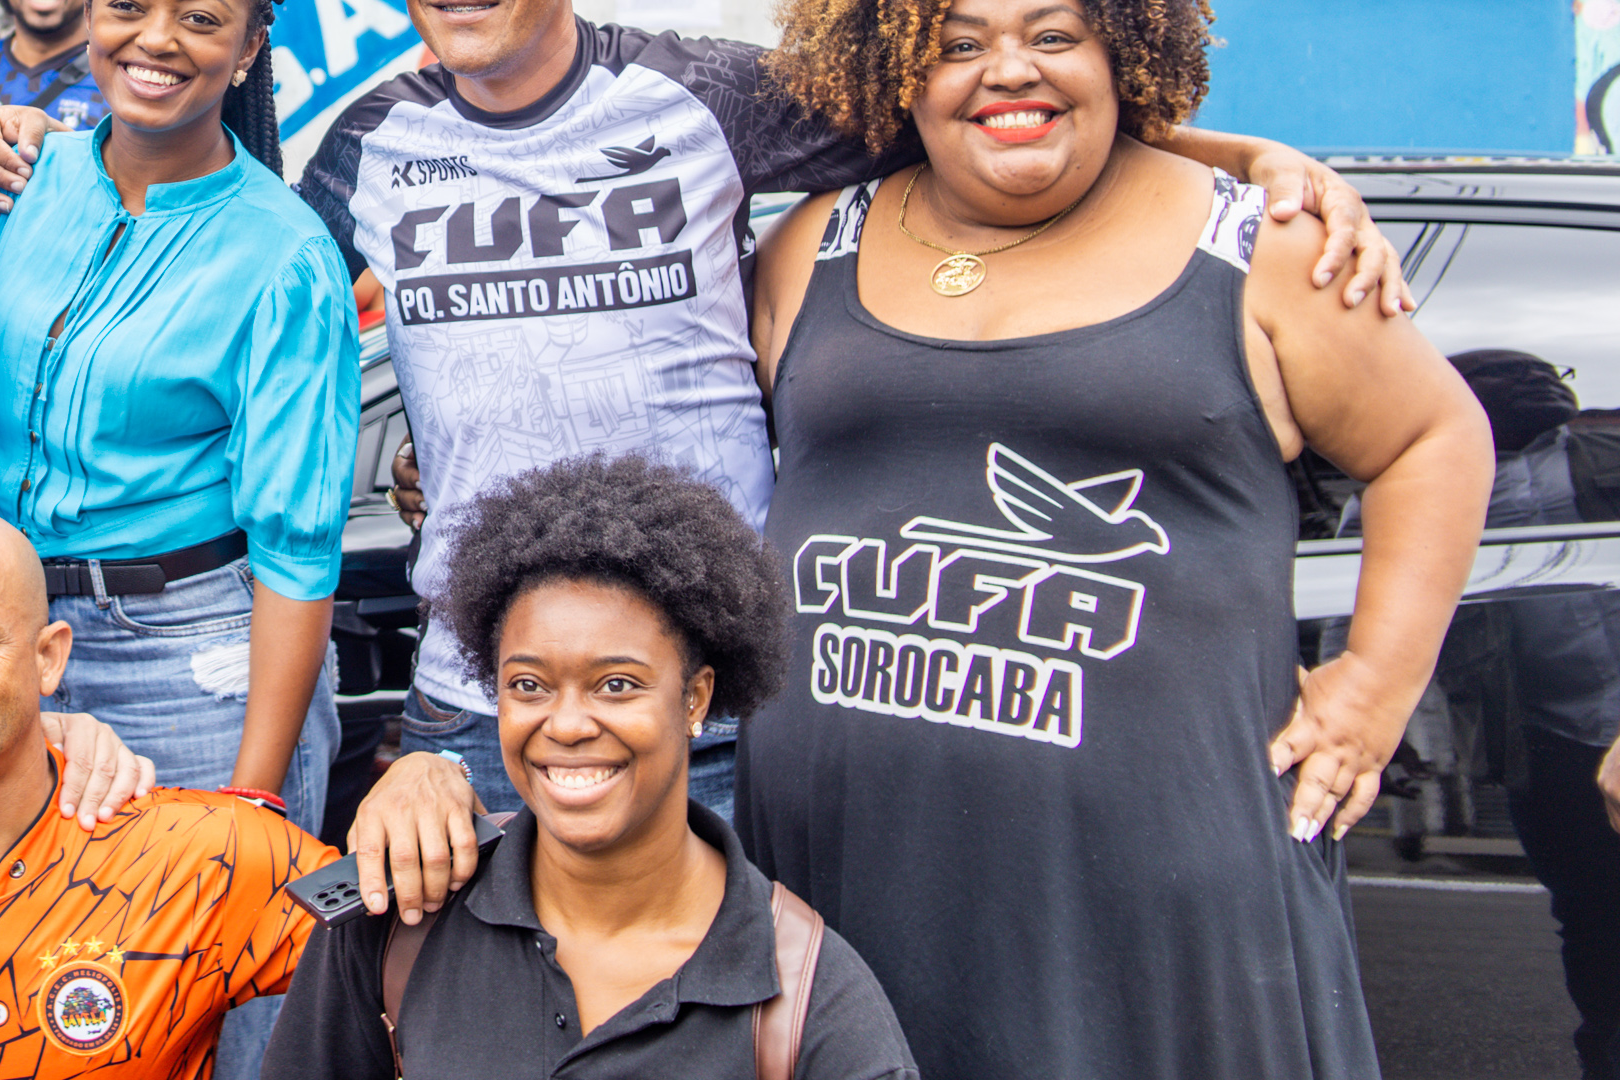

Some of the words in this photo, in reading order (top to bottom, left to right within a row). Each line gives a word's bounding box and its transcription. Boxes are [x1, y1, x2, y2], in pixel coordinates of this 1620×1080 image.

[416, 155, 478, 185] SPORTS
[390, 177, 687, 271] CUFA
[400, 287, 445, 322] PQ.
[448, 278, 549, 317] SANTO
[556, 262, 688, 311] ANTÔNIO
[793, 534, 1145, 660] CUFA
[812, 624, 1081, 746] SOROCABA
